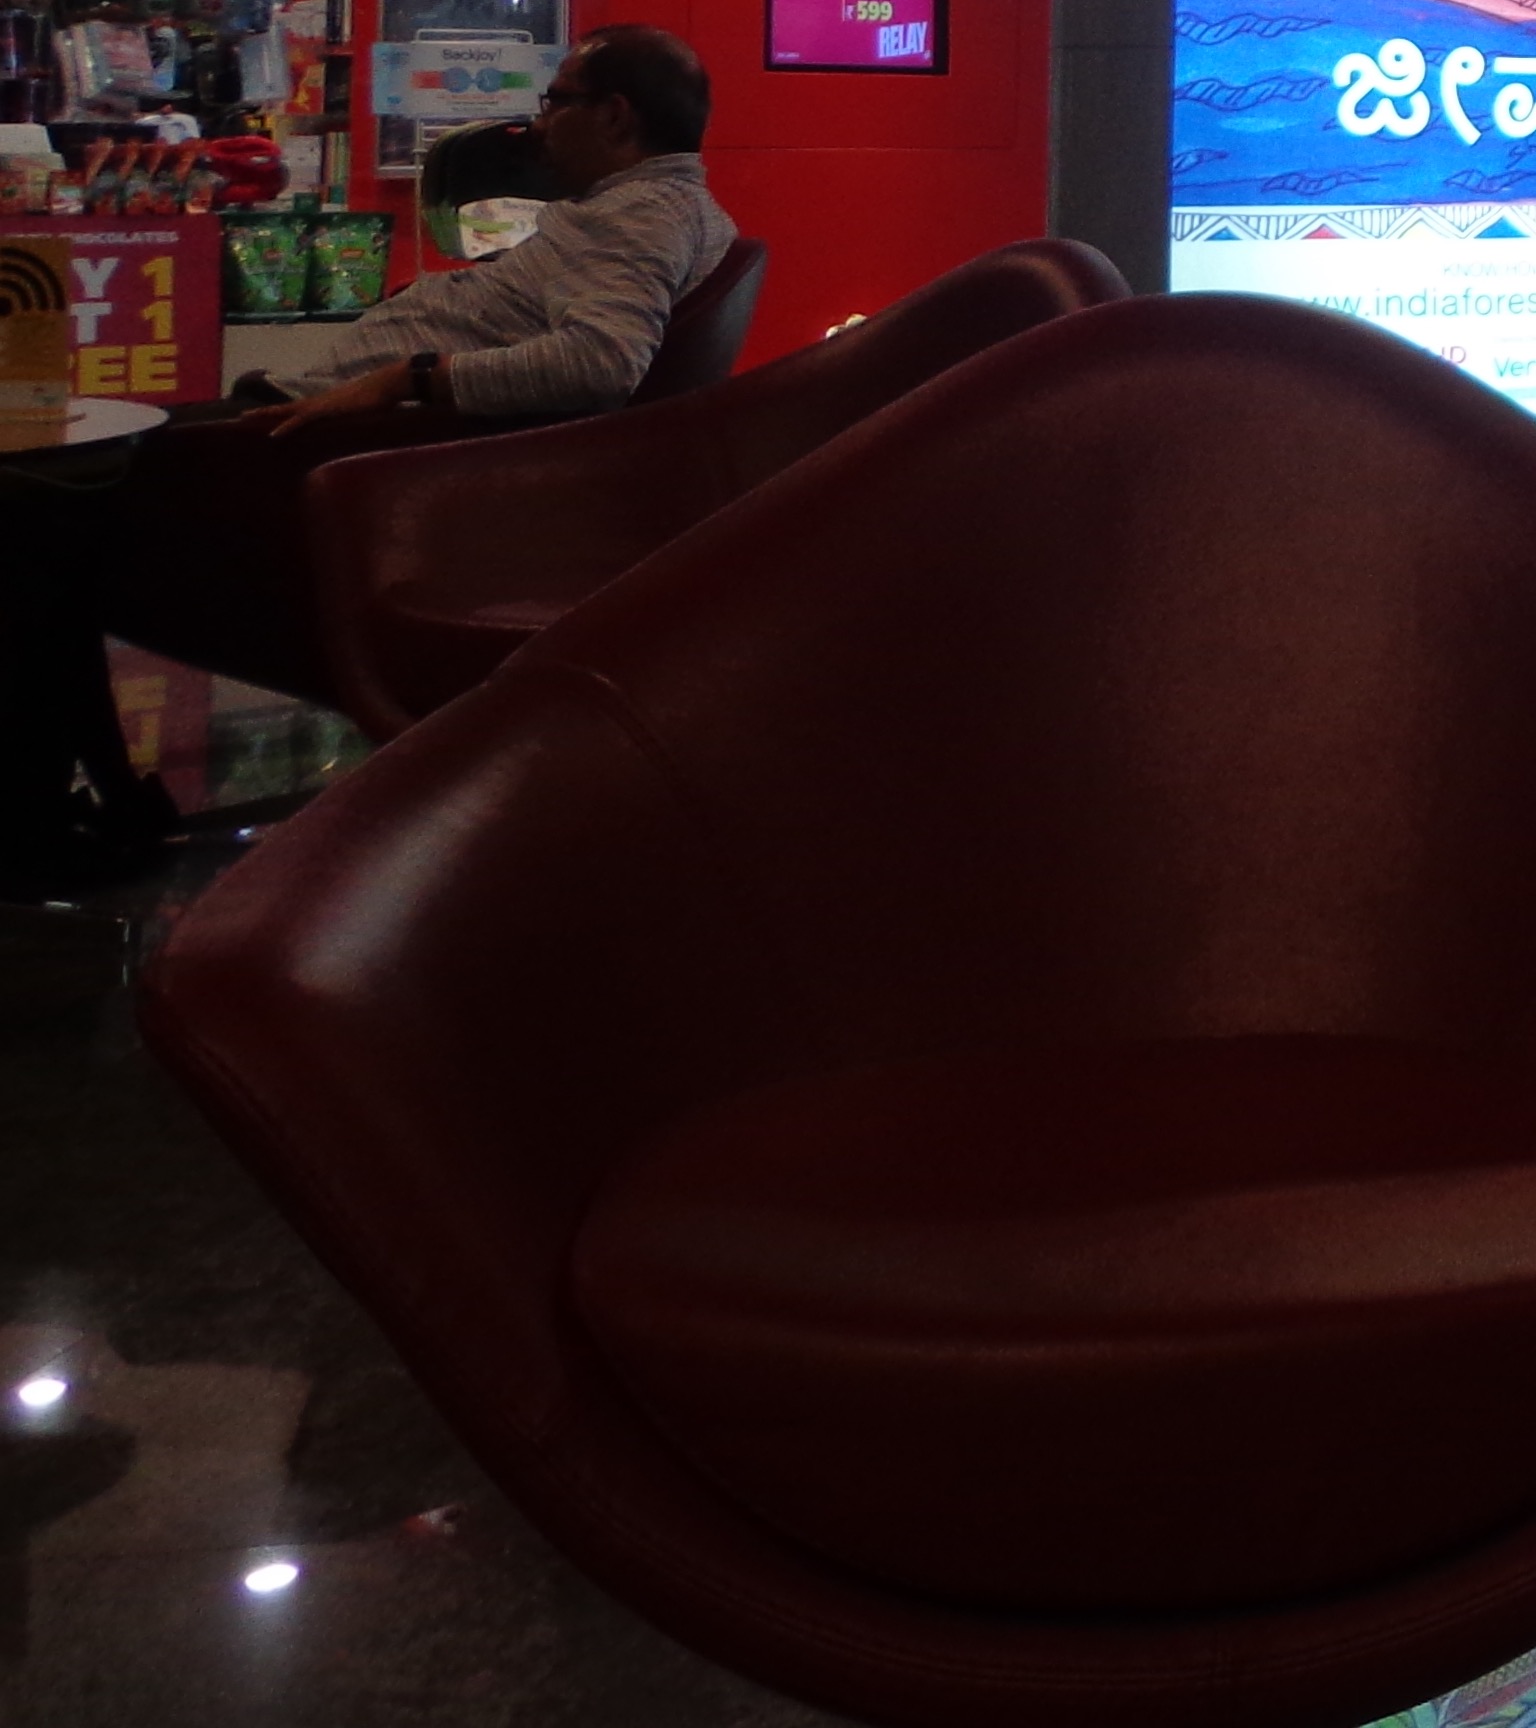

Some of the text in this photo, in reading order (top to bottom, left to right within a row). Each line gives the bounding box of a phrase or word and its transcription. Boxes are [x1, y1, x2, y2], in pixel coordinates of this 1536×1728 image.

[856, 0, 893, 21] 599
[878, 21, 928, 59] RELAY
[140, 255, 174, 297] 1
[1441, 262, 1498, 277] KNOW
[141, 300, 174, 340] 1
[68, 343, 178, 396] EE
